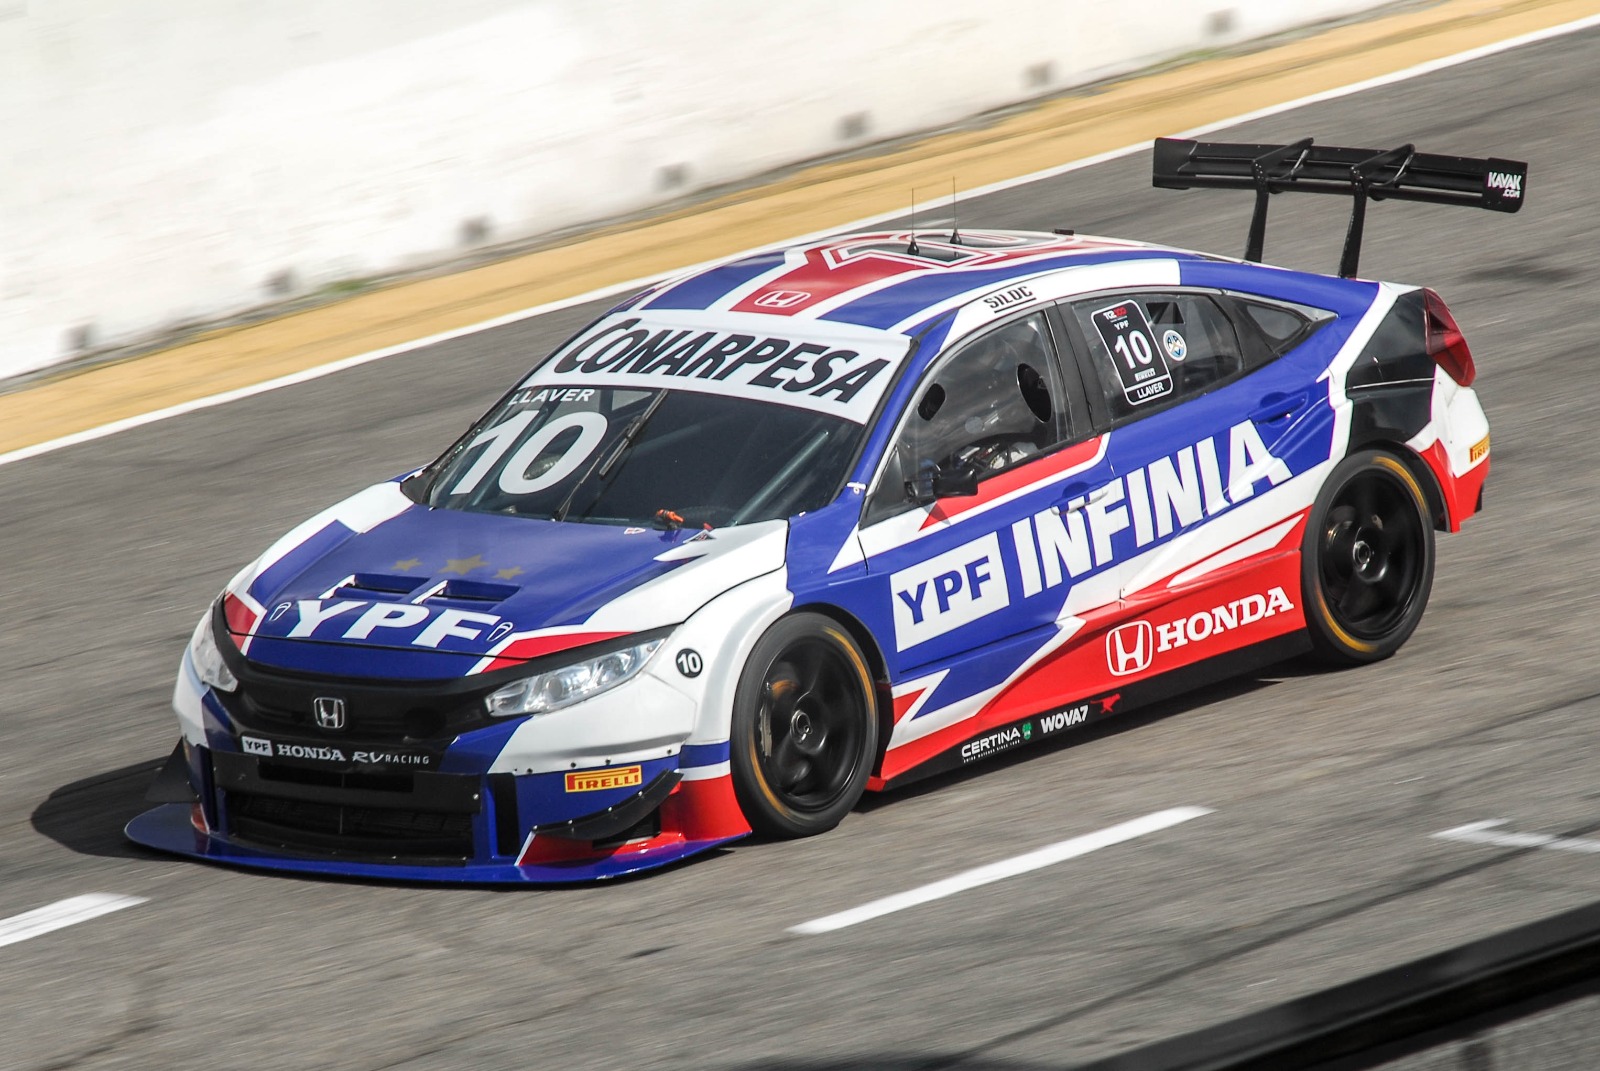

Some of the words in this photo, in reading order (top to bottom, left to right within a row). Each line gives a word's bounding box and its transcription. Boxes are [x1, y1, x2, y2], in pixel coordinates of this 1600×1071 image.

[1487, 171, 1522, 190] KAVAK
[983, 286, 1033, 308] SILDC
[1114, 320, 1129, 330] YPF
[554, 318, 891, 404] CONARPESA
[1114, 330, 1153, 369] 10
[508, 389, 595, 405] LLAVER
[1136, 382, 1164, 398] LLAVER
[450, 410, 608, 495] 10
[897, 559, 991, 624] YPF
[1011, 418, 1293, 599] INFINIA
[286, 600, 502, 648] YPF
[1157, 586, 1294, 652] HONDA
[677, 652, 700, 674] 10
[1040, 705, 1089, 733] WOVA7
[245, 740, 269, 753] YPF
[276, 744, 346, 762] HONDA
[961, 727, 1021, 758] CERTINA
[566, 768, 640, 790] PIRELLI
